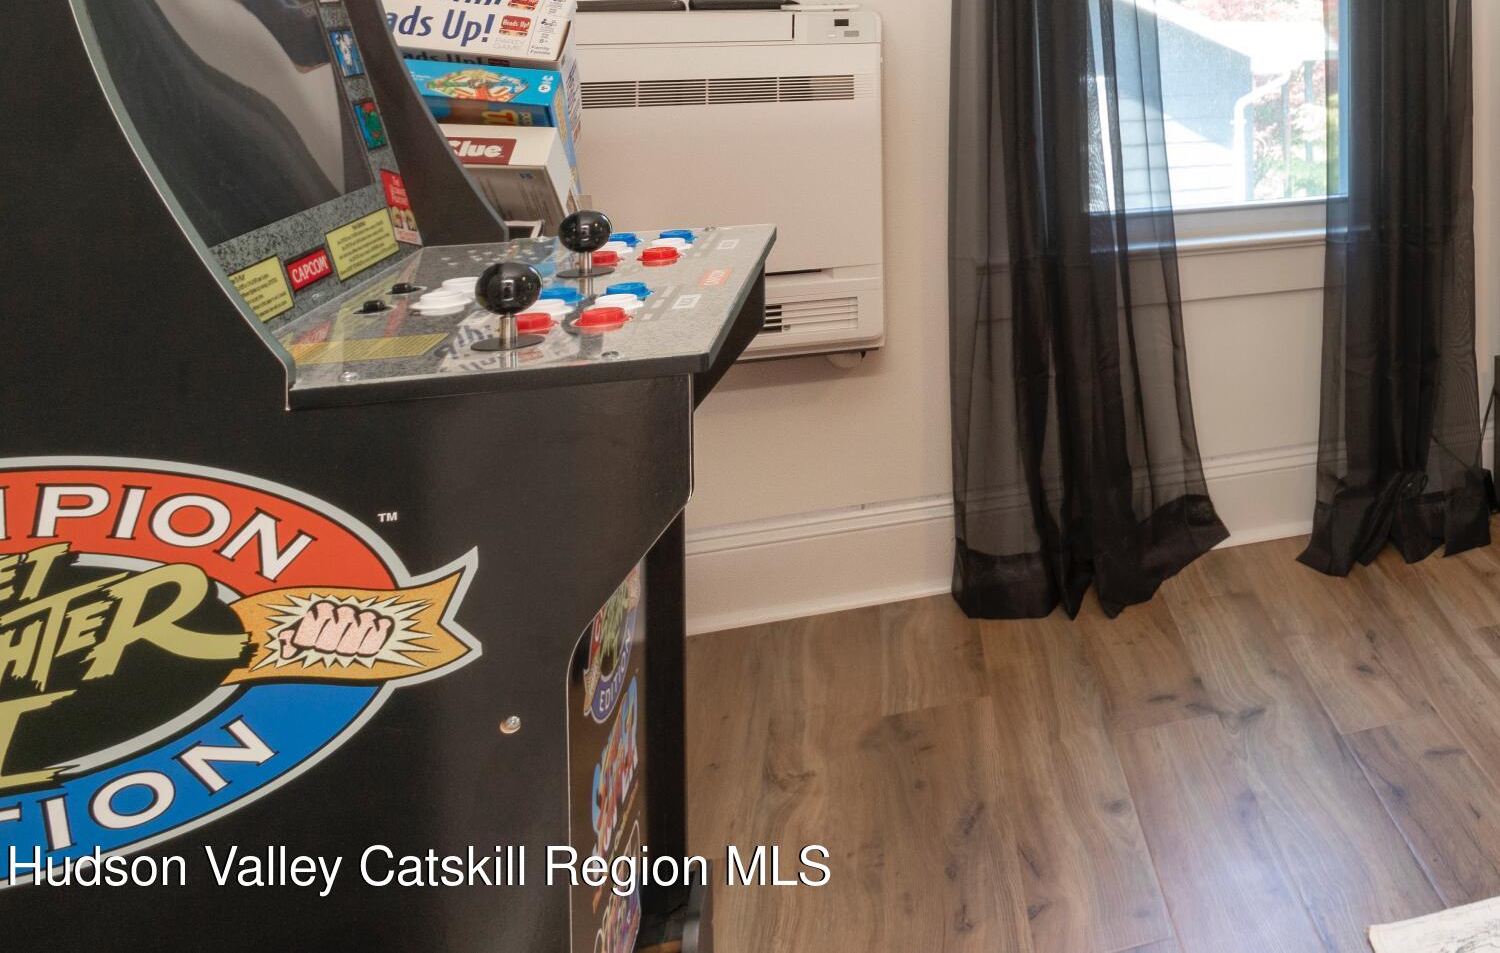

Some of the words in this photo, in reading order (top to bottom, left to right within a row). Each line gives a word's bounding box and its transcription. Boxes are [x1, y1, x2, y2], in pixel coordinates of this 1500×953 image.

[386, 5, 434, 37] ads
[442, 9, 495, 47] Up!
[292, 254, 328, 284] CAPCOM
[0, 483, 317, 582] PION
[378, 511, 398, 522] TM
[599, 630, 632, 712] EDITION
